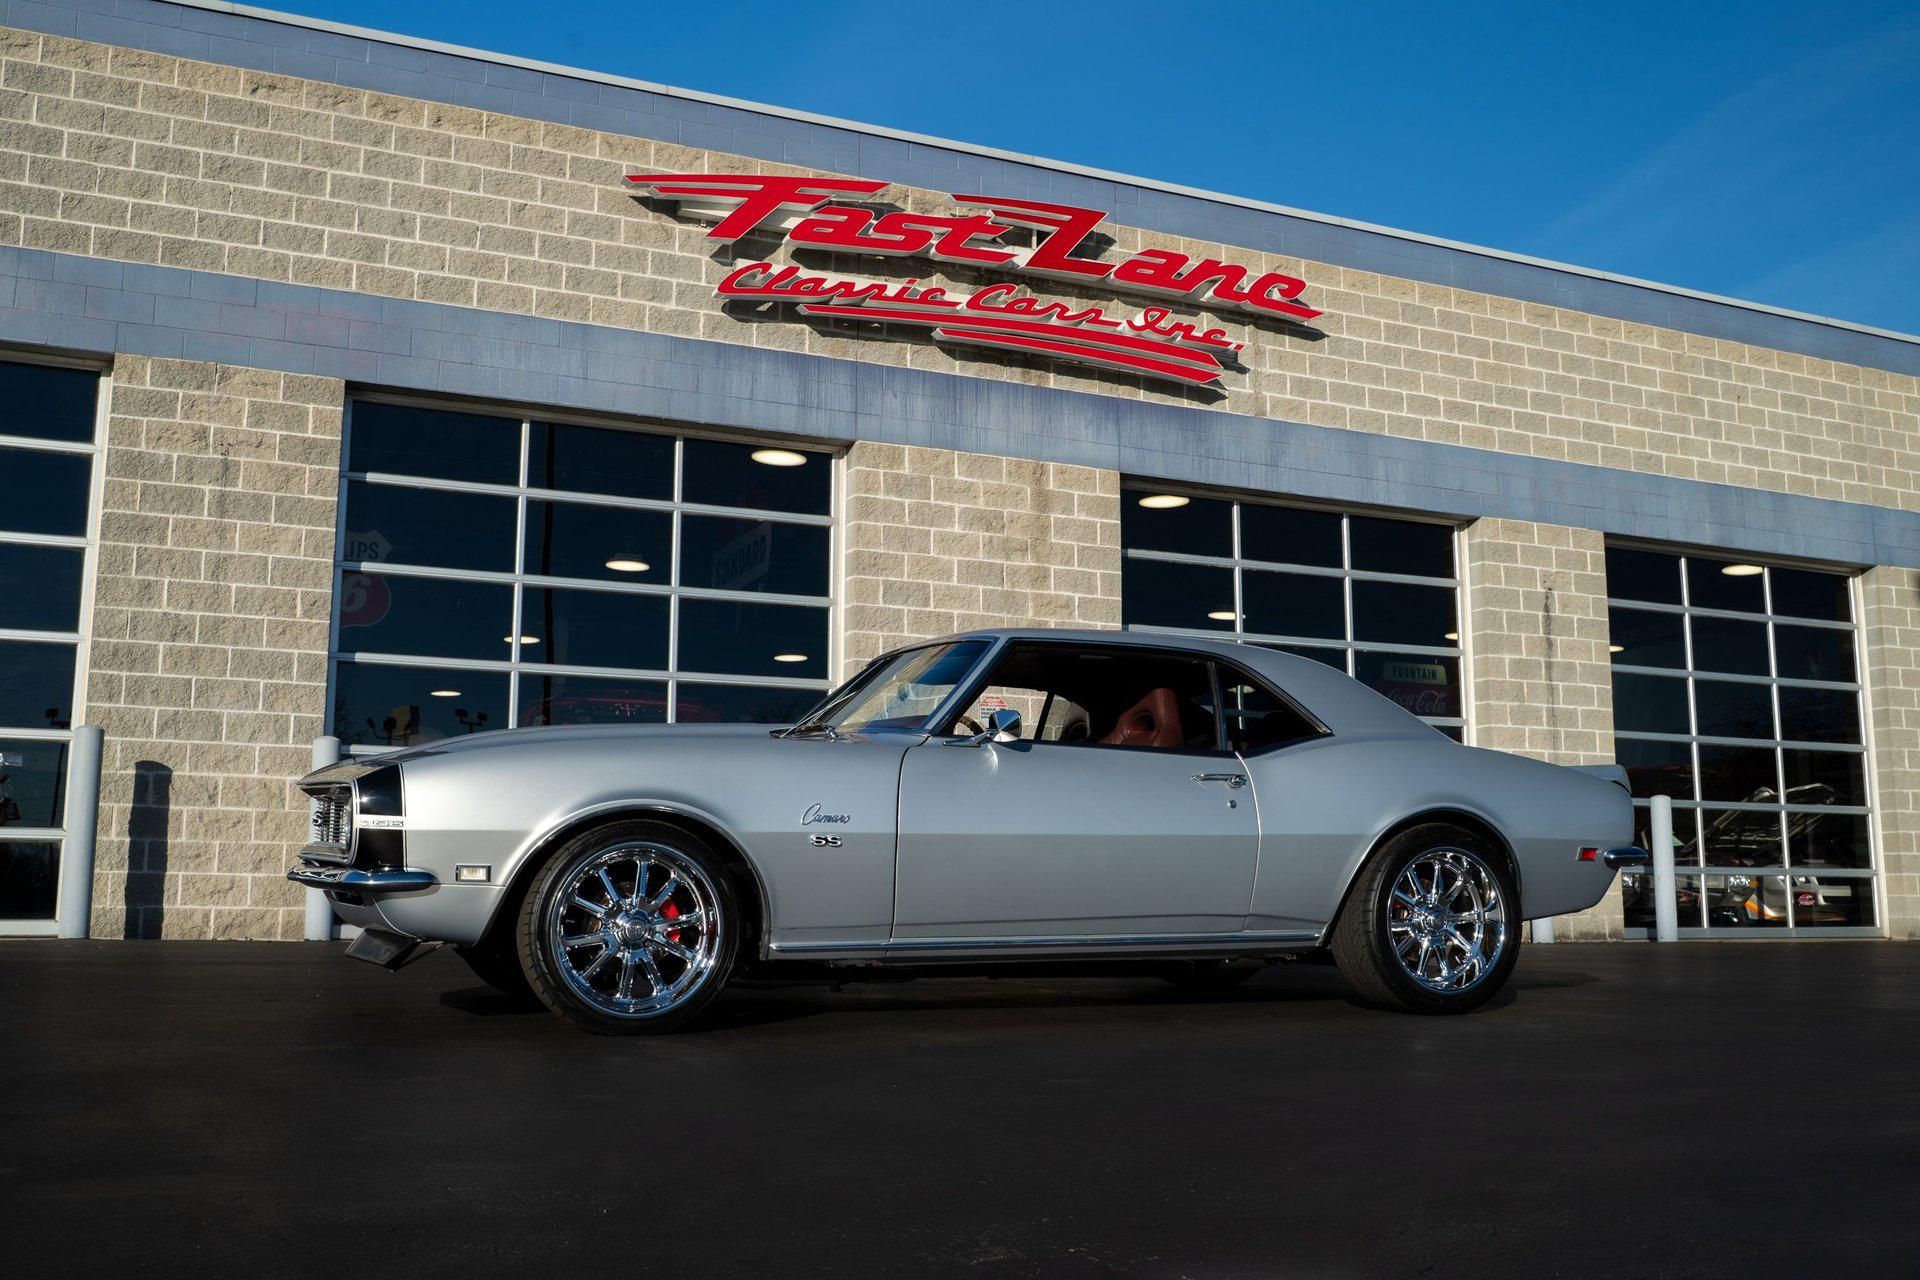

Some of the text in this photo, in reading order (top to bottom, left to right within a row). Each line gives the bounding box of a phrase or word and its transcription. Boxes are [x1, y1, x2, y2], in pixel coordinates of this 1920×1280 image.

[623, 174, 1325, 322] Fast Lane
[716, 262, 963, 307] Classic
[965, 283, 1124, 327] Cars
[1392, 666, 1437, 680] FOUNTAIN
[802, 803, 851, 825] Camaro
[811, 835, 842, 848] SS
